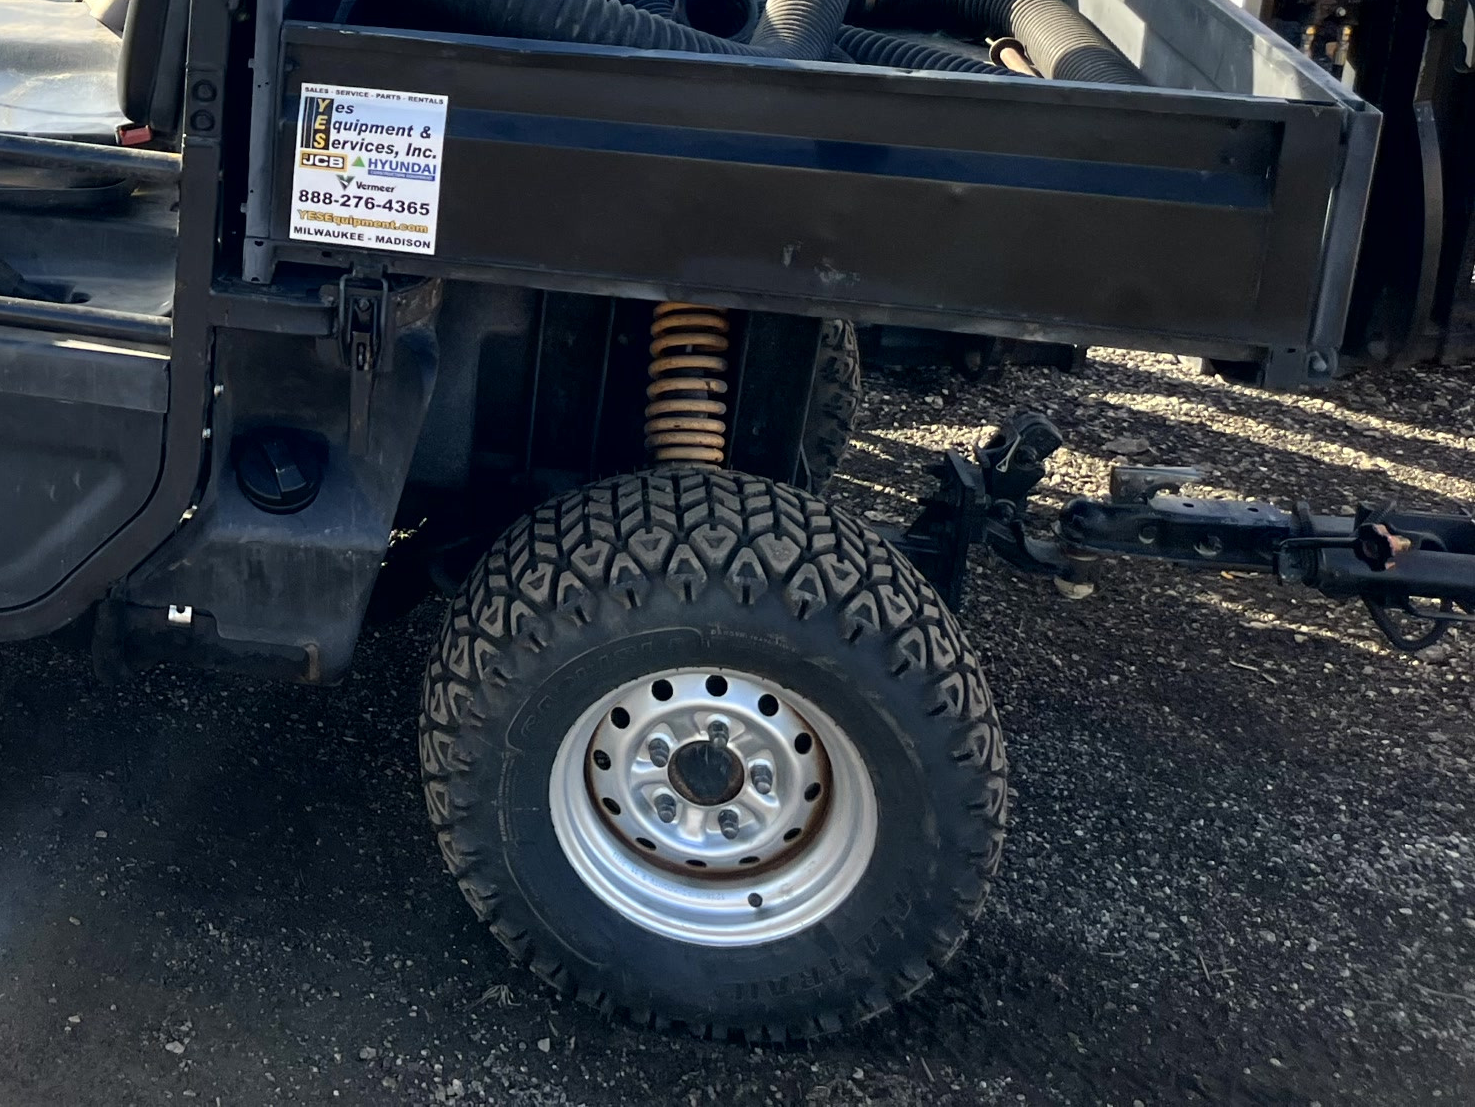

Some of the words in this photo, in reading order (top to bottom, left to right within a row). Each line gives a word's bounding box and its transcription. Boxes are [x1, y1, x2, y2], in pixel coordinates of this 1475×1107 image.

[304, 86, 329, 94] SALES
[335, 89, 369, 98] SERVICE
[375, 93, 401, 101] PARTS
[408, 96, 444, 105] RENTALS
[420, 125, 432, 139] &
[405, 143, 437, 160] Inc.
[302, 154, 344, 168] JCB
[368, 157, 437, 175] HYUNDAI
[356, 180, 395, 193] Vermeer
[298, 189, 430, 216] 888-276-4365
[297, 209, 429, 234] YESEquipment.com
[293, 225, 365, 241] MILWAUKEE
[375, 235, 431, 249] MADISON
